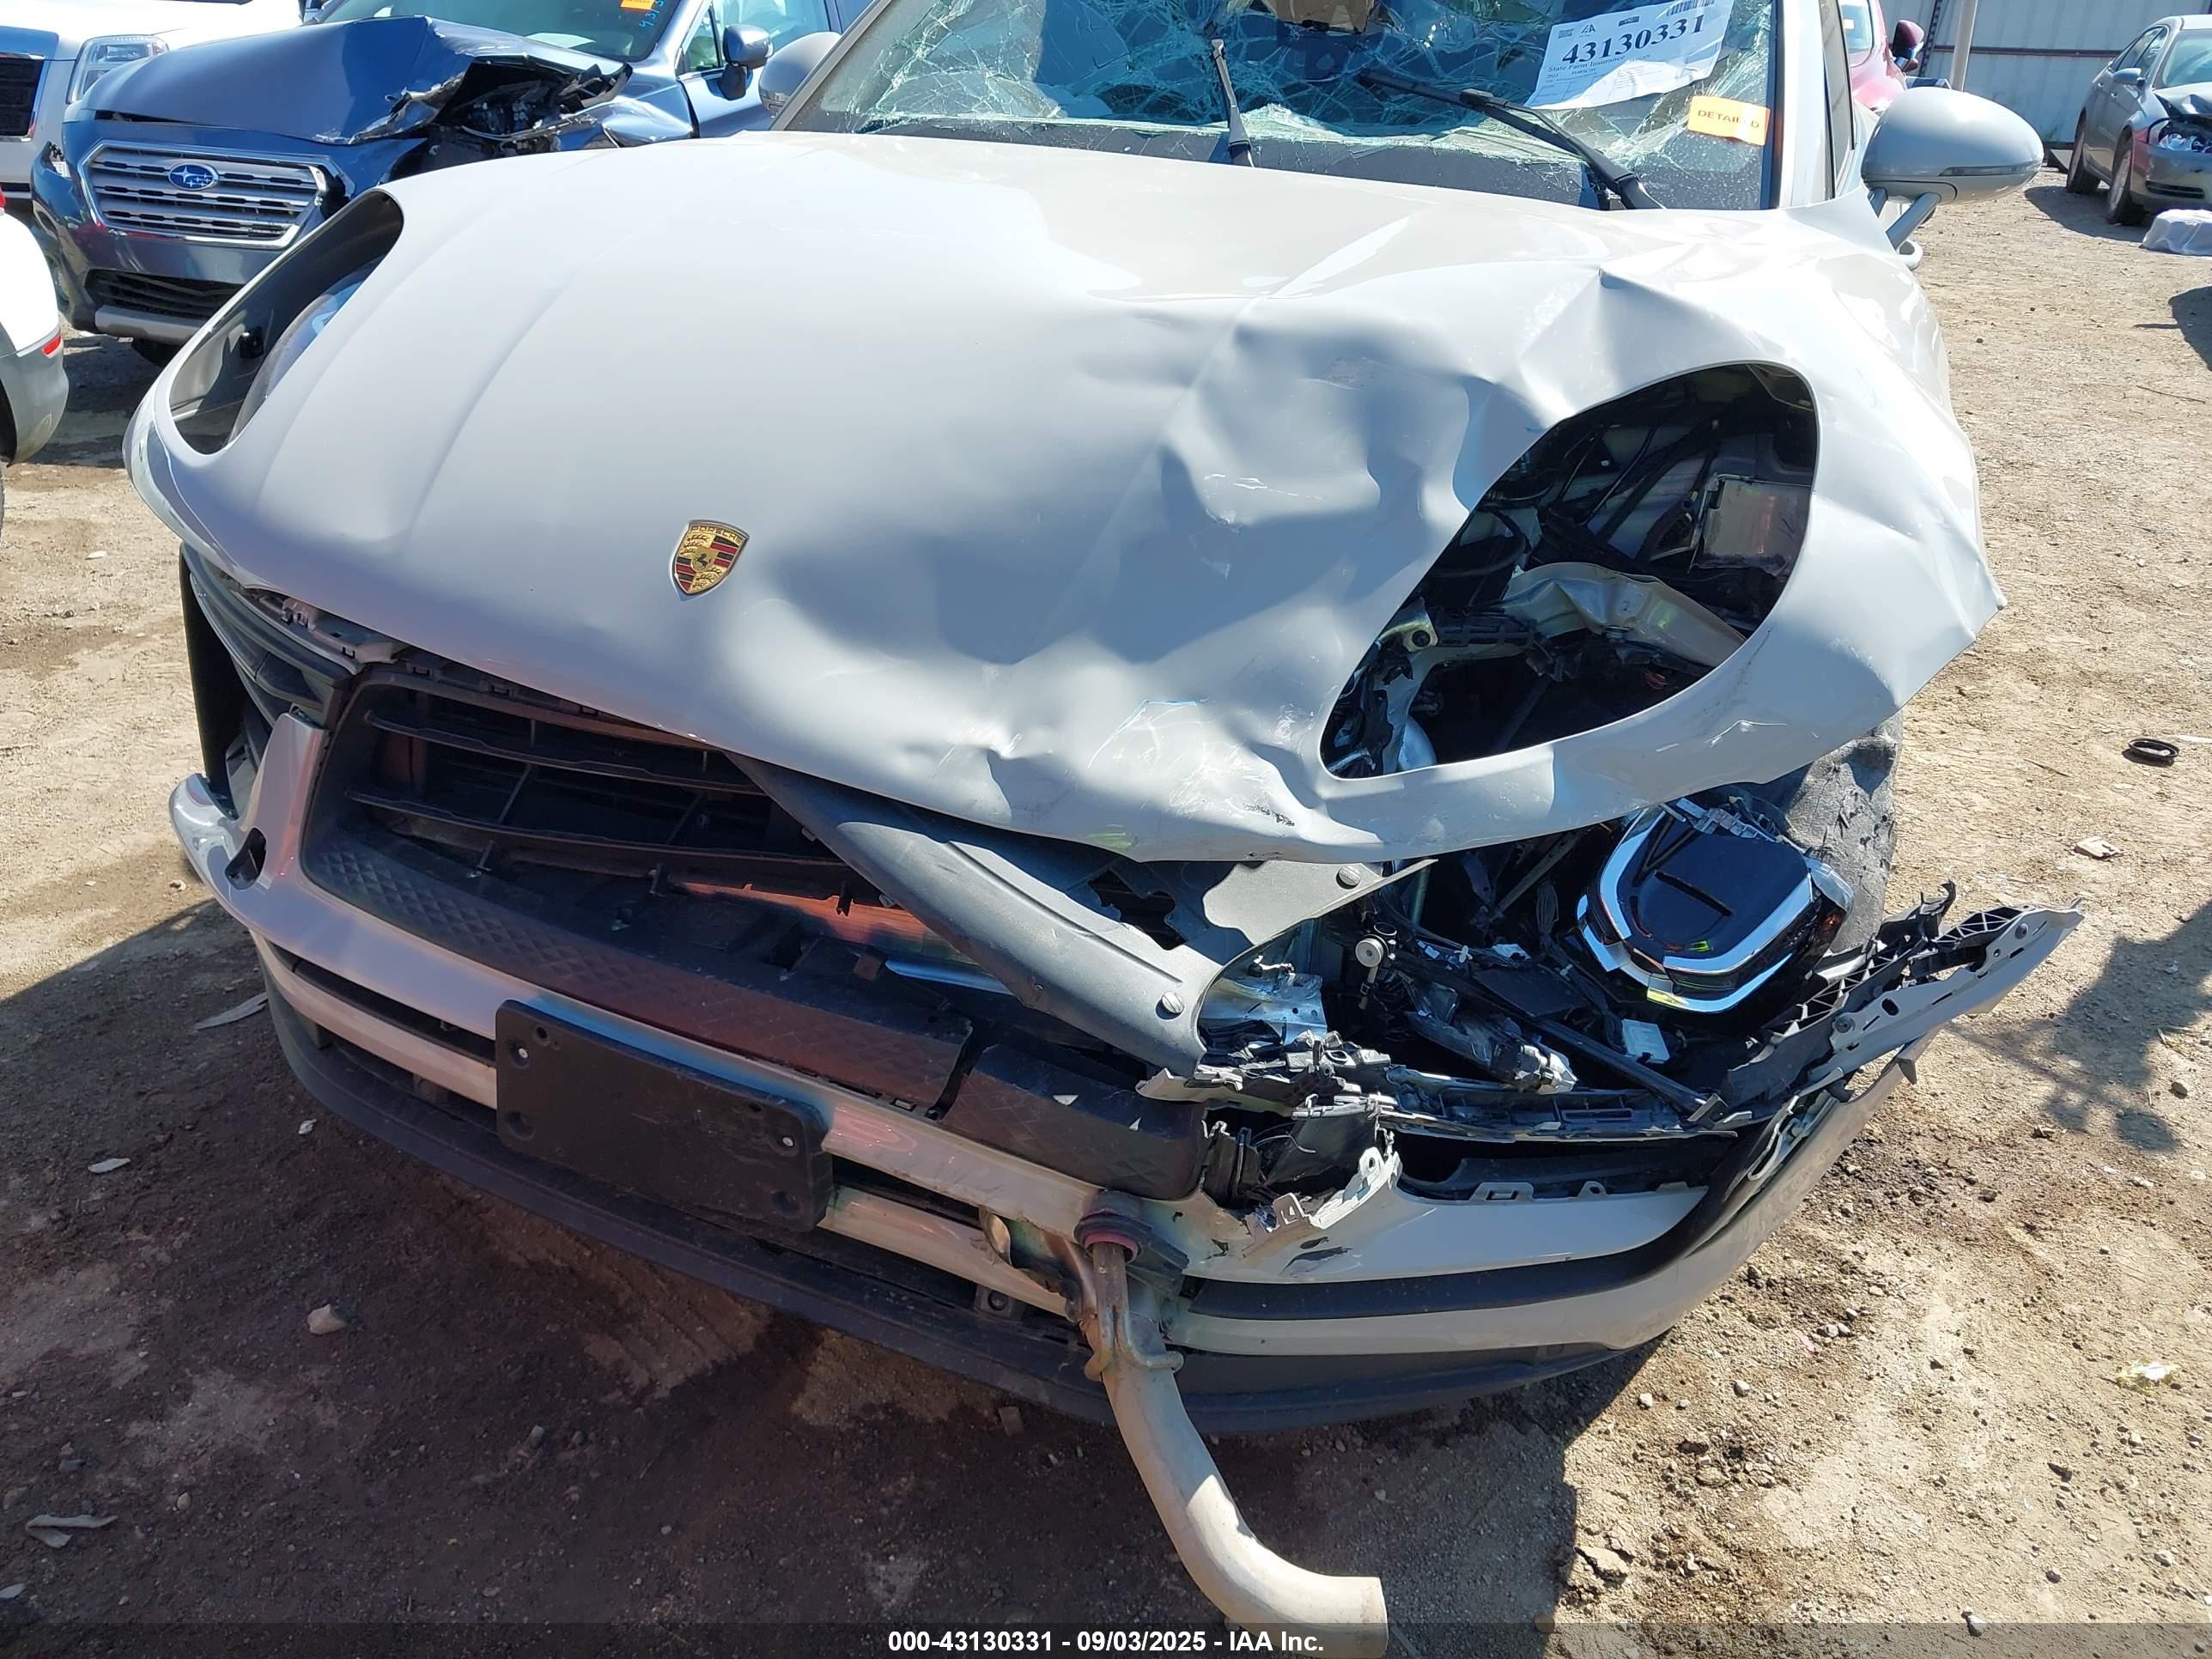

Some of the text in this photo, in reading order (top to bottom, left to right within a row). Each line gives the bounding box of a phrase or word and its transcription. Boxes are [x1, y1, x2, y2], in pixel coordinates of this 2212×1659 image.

[1562, 14, 1705, 64] 43130331
[1698, 109, 1759, 128] DETAILD
[690, 526, 743, 544] PORSCHE
